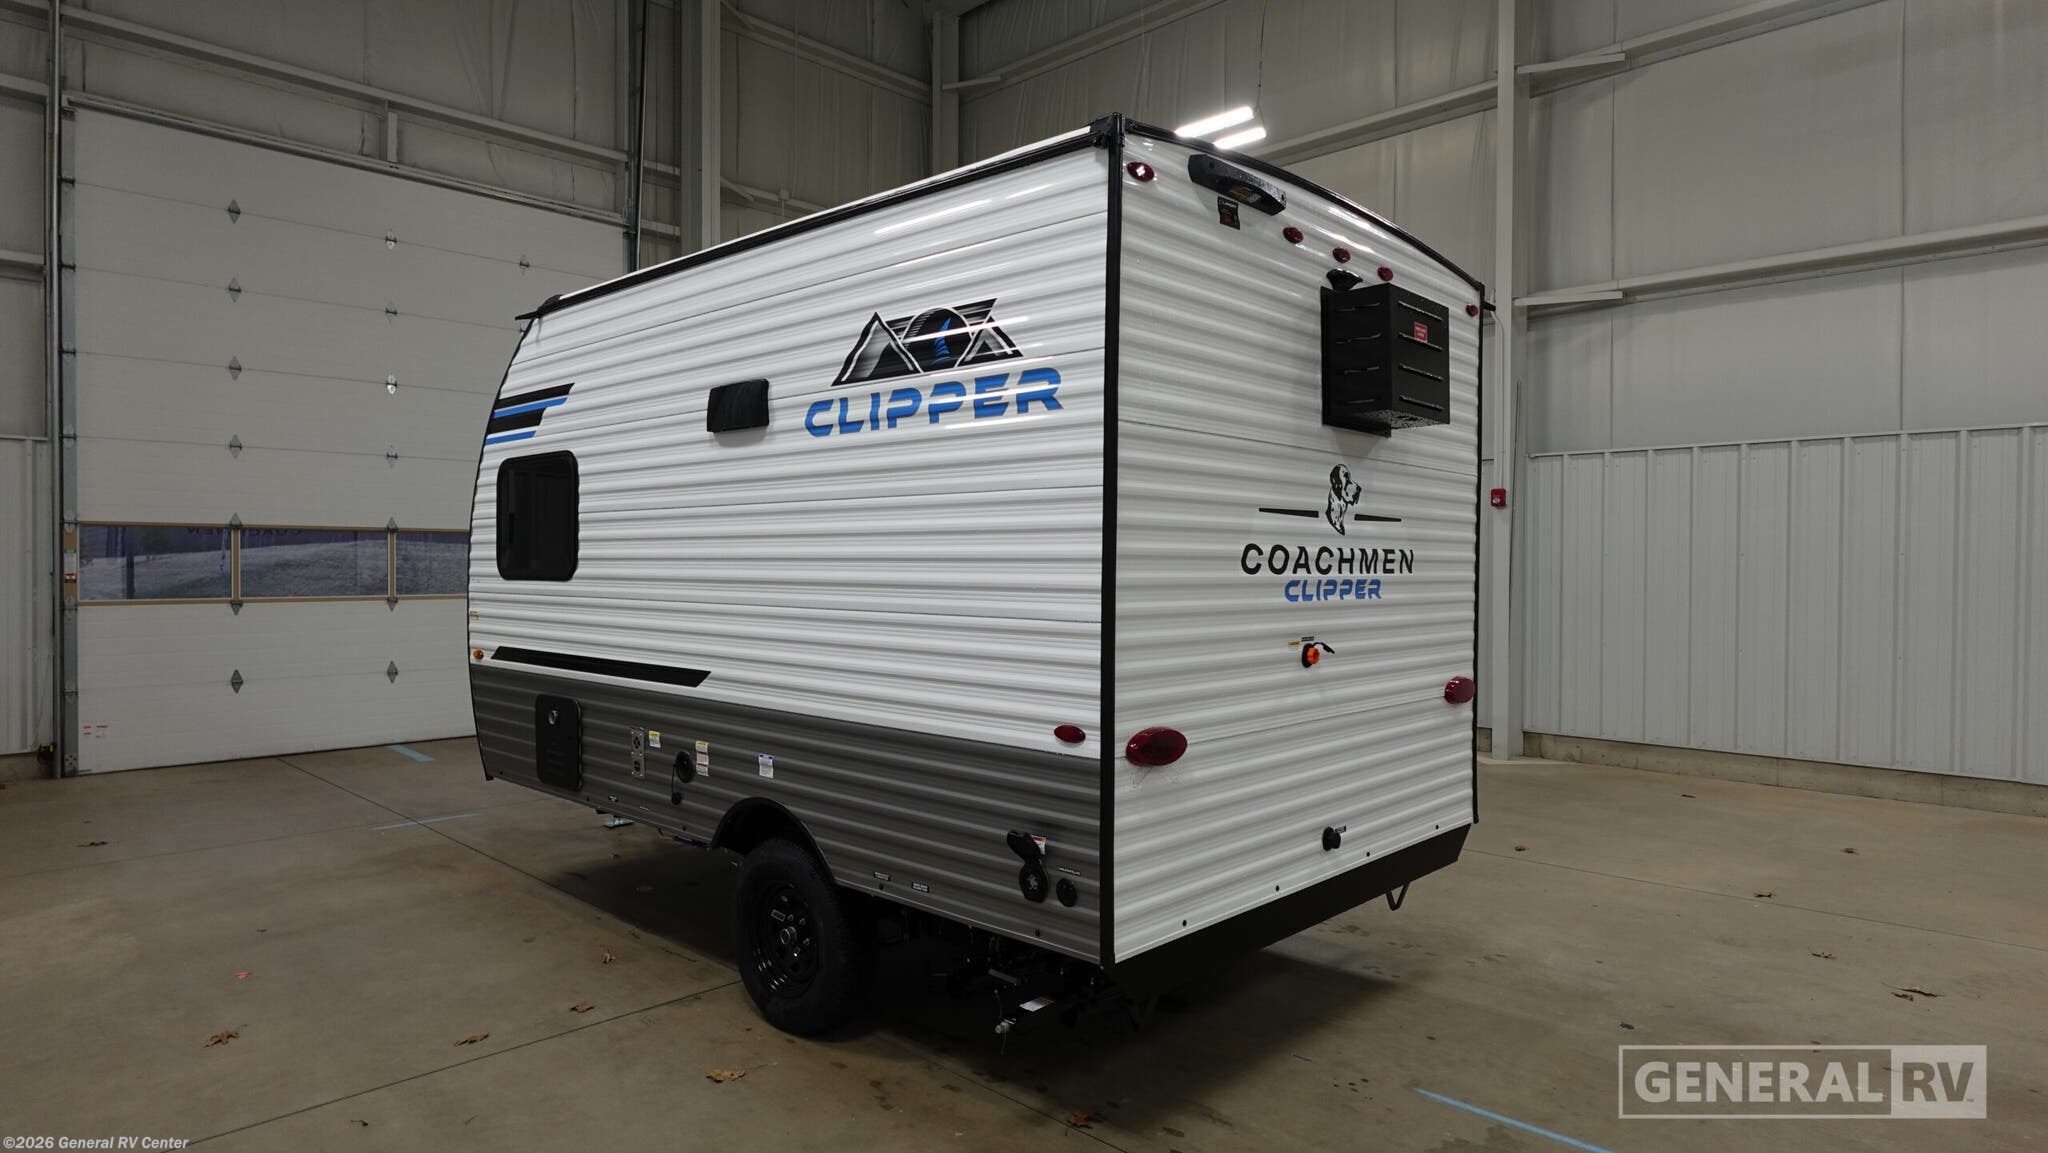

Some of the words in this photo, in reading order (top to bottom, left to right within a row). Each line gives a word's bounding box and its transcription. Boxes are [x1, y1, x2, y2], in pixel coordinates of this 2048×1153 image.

[804, 367, 1065, 438] CLIPPER
[1240, 543, 1414, 576] COACHMEN
[1284, 578, 1382, 602] CLIPPER
